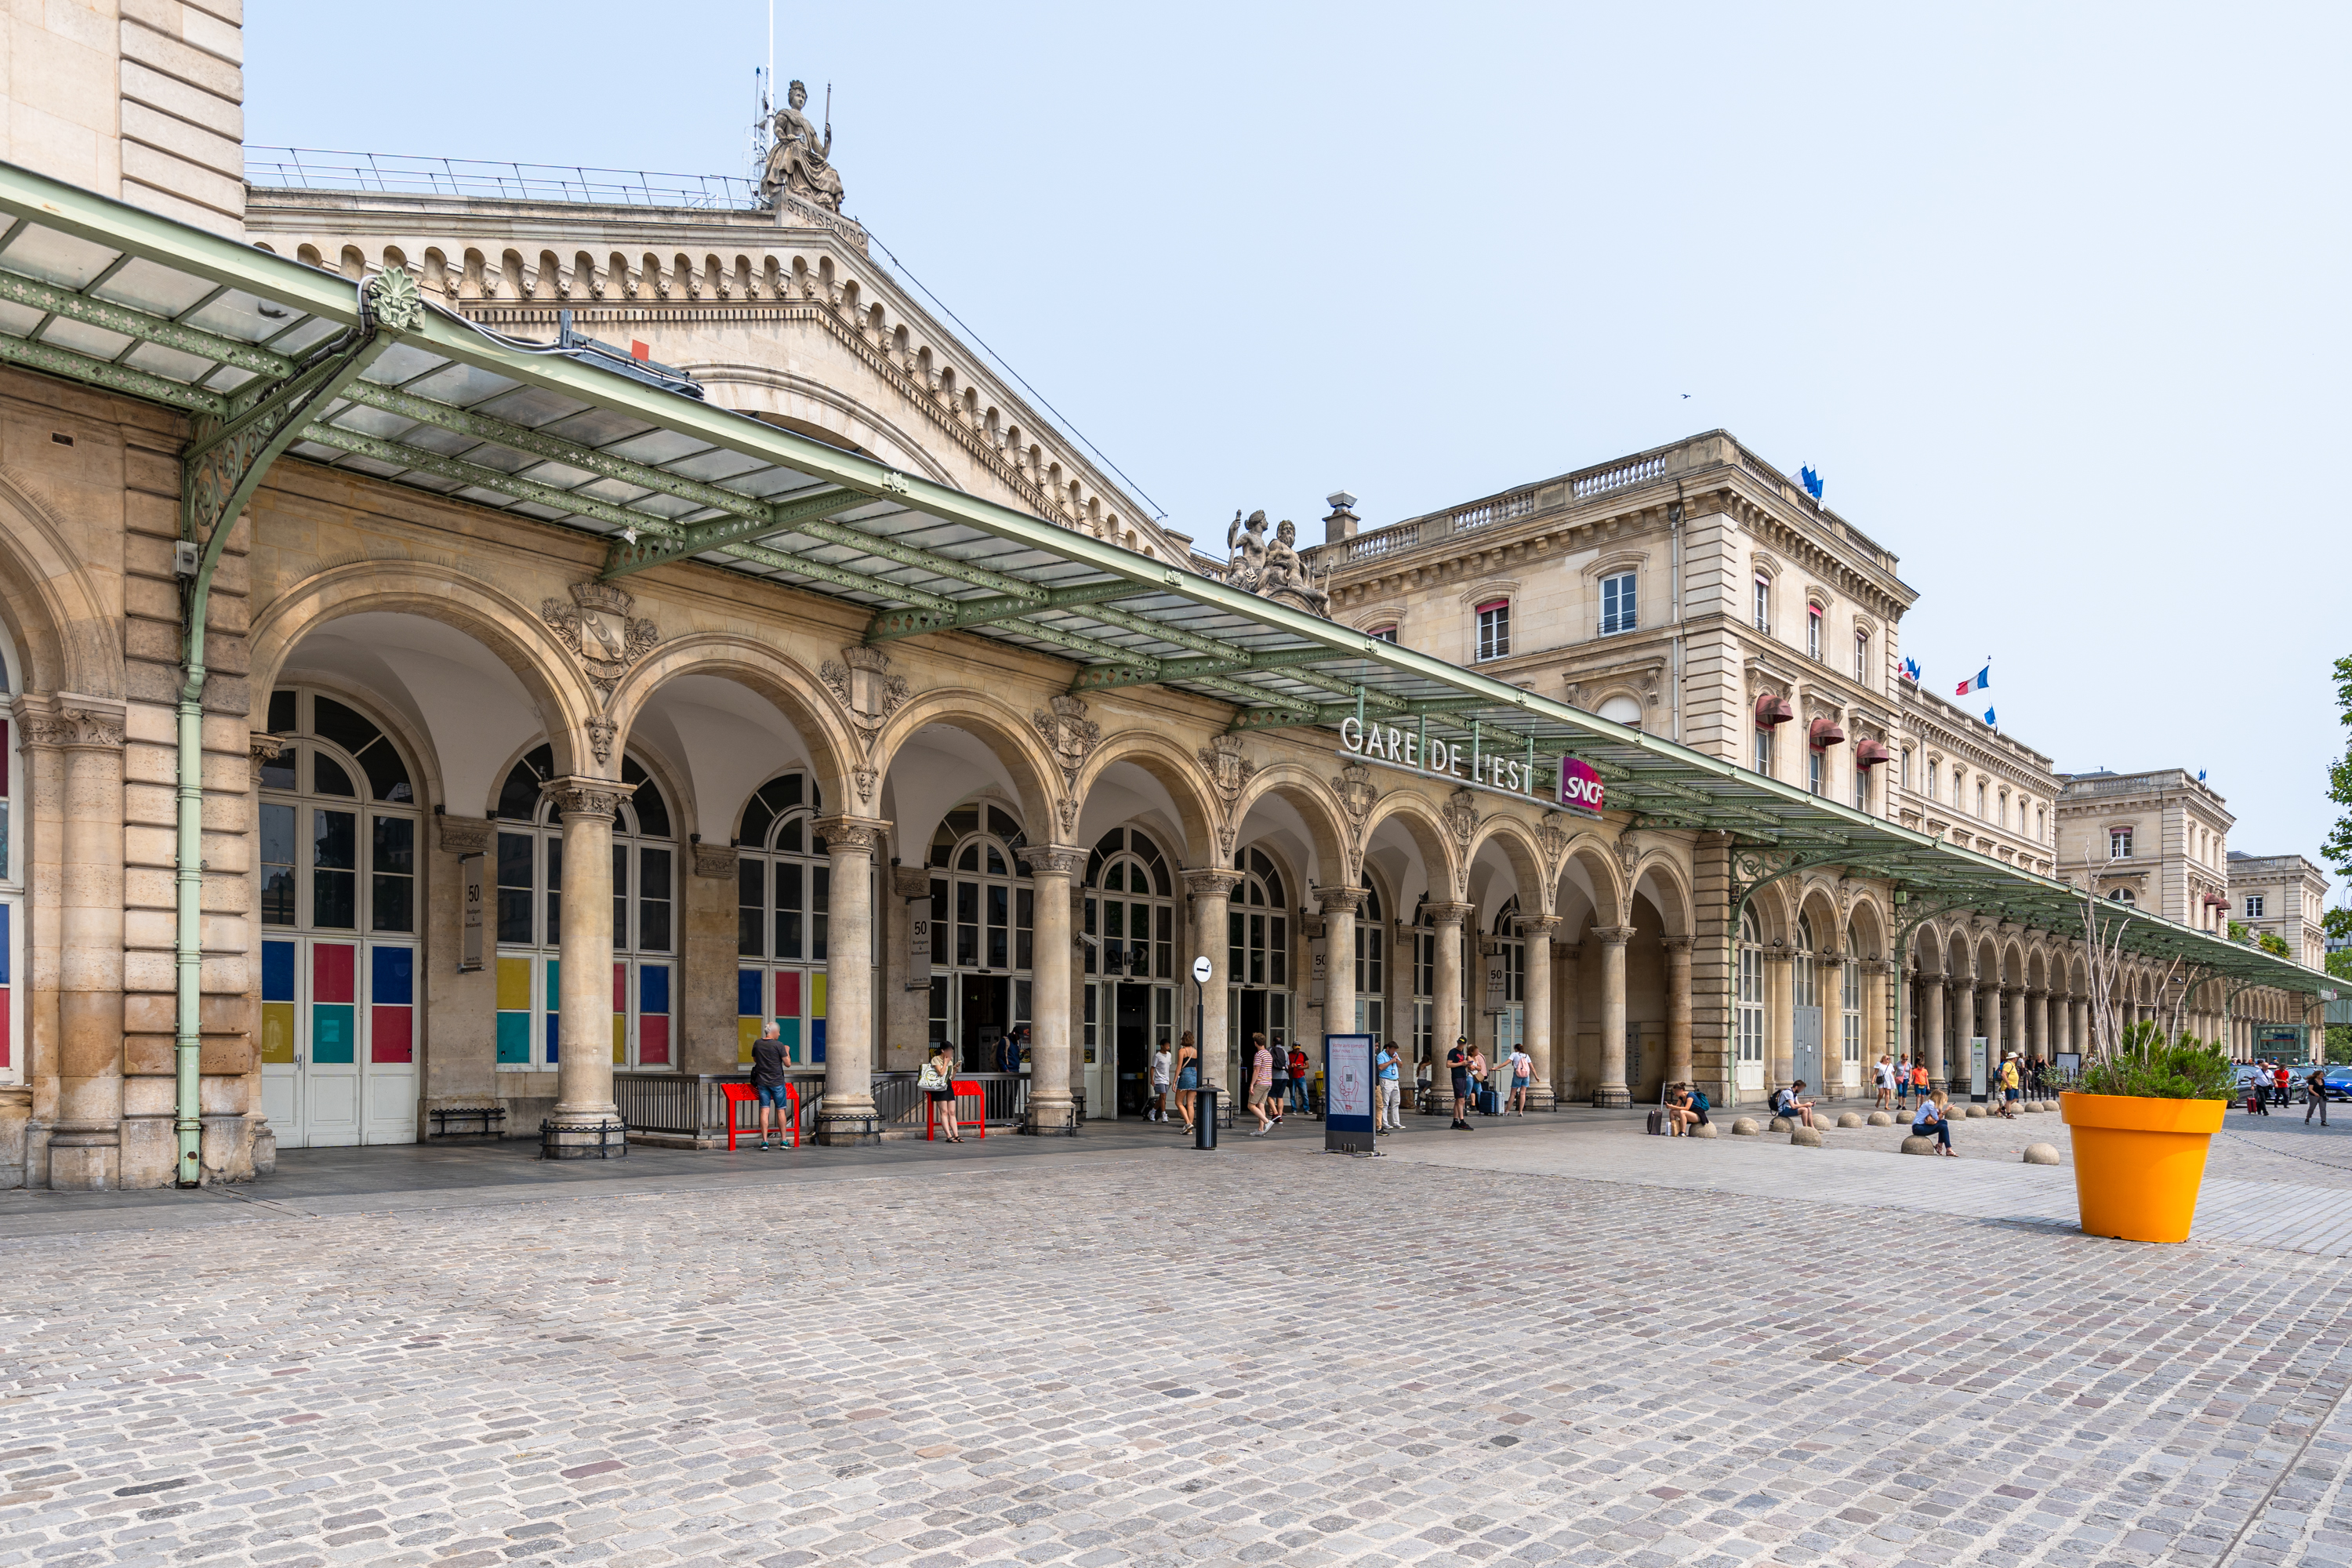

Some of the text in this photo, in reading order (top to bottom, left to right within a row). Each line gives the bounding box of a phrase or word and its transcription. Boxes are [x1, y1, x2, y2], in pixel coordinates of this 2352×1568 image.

[787, 198, 865, 246] STRASBOVRG
[584, 662, 622, 677] LVNEVILLE
[1340, 717, 1532, 793] GARE DE L'EST
[1565, 776, 1604, 804] SNCF
[469, 884, 479, 902] 50
[914, 920, 927, 935] 50
[1490, 969, 1502, 979] 50
